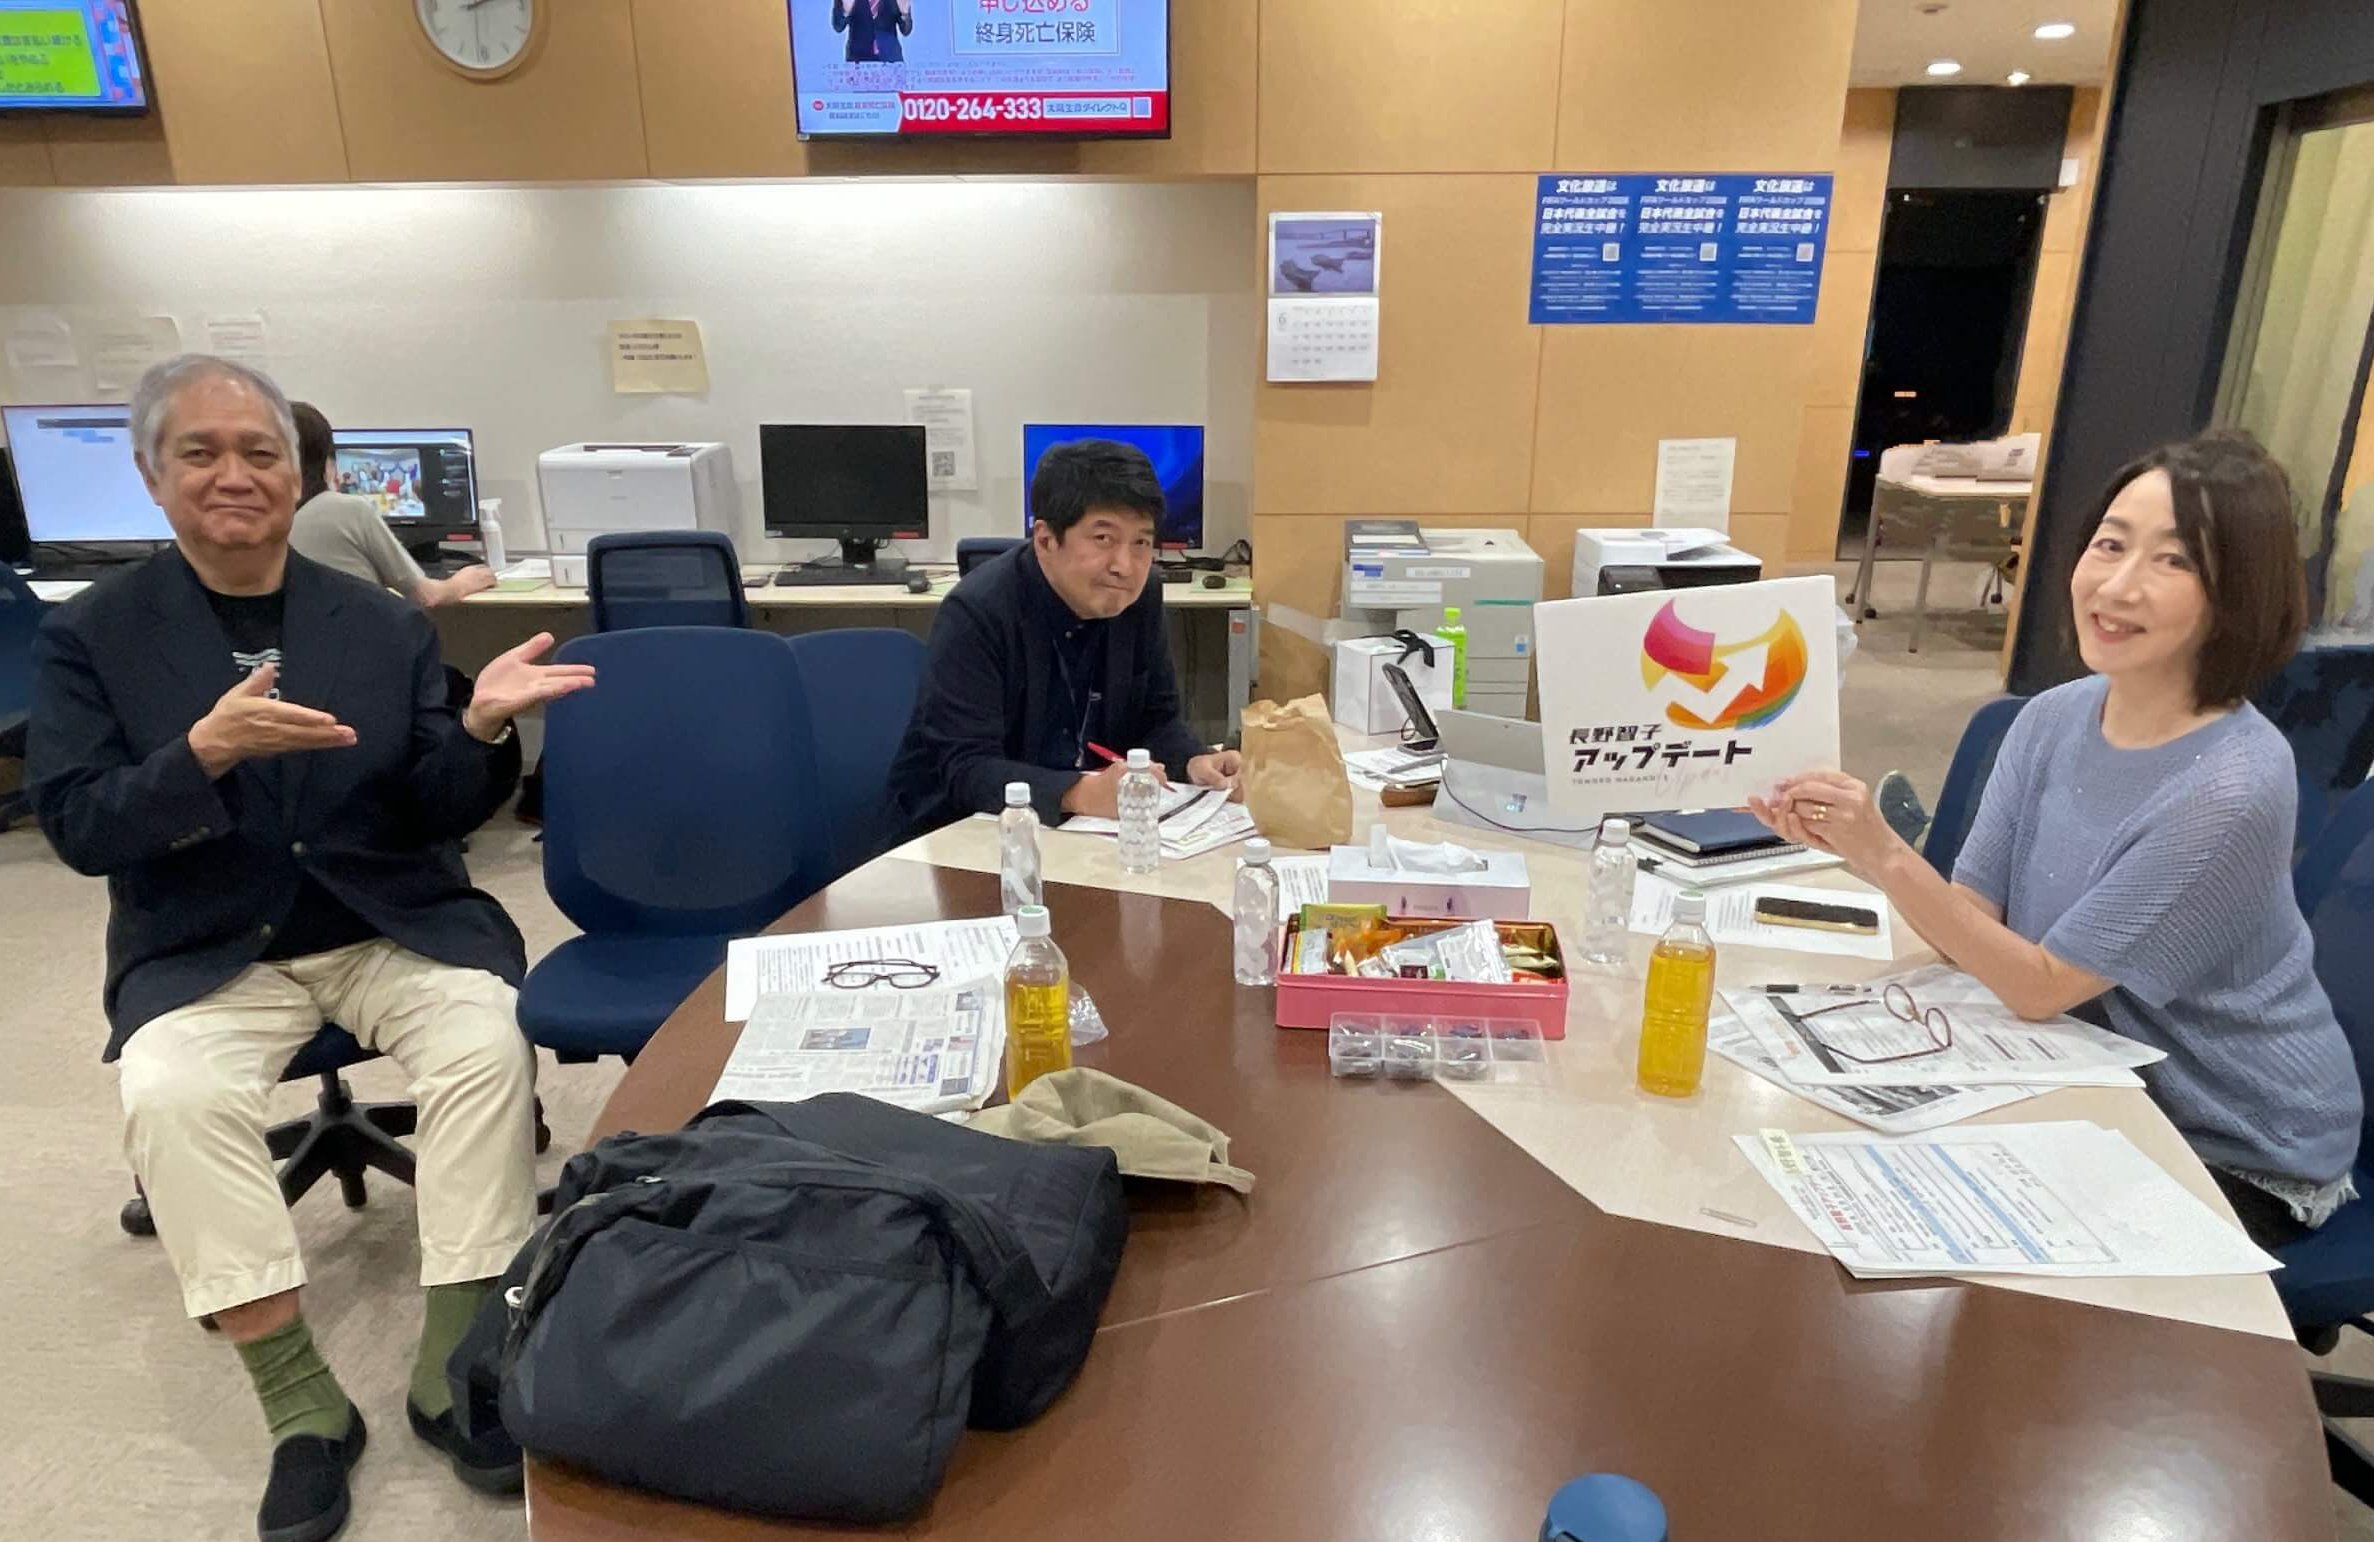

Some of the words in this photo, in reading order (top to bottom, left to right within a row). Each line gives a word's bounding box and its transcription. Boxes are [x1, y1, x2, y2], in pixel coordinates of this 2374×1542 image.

[975, 21, 1096, 43] 終身死亡保険
[904, 97, 1042, 121] 0120-264-333
[1569, 724, 1661, 744] 長野智子
[1573, 740, 1752, 772] アップデート
